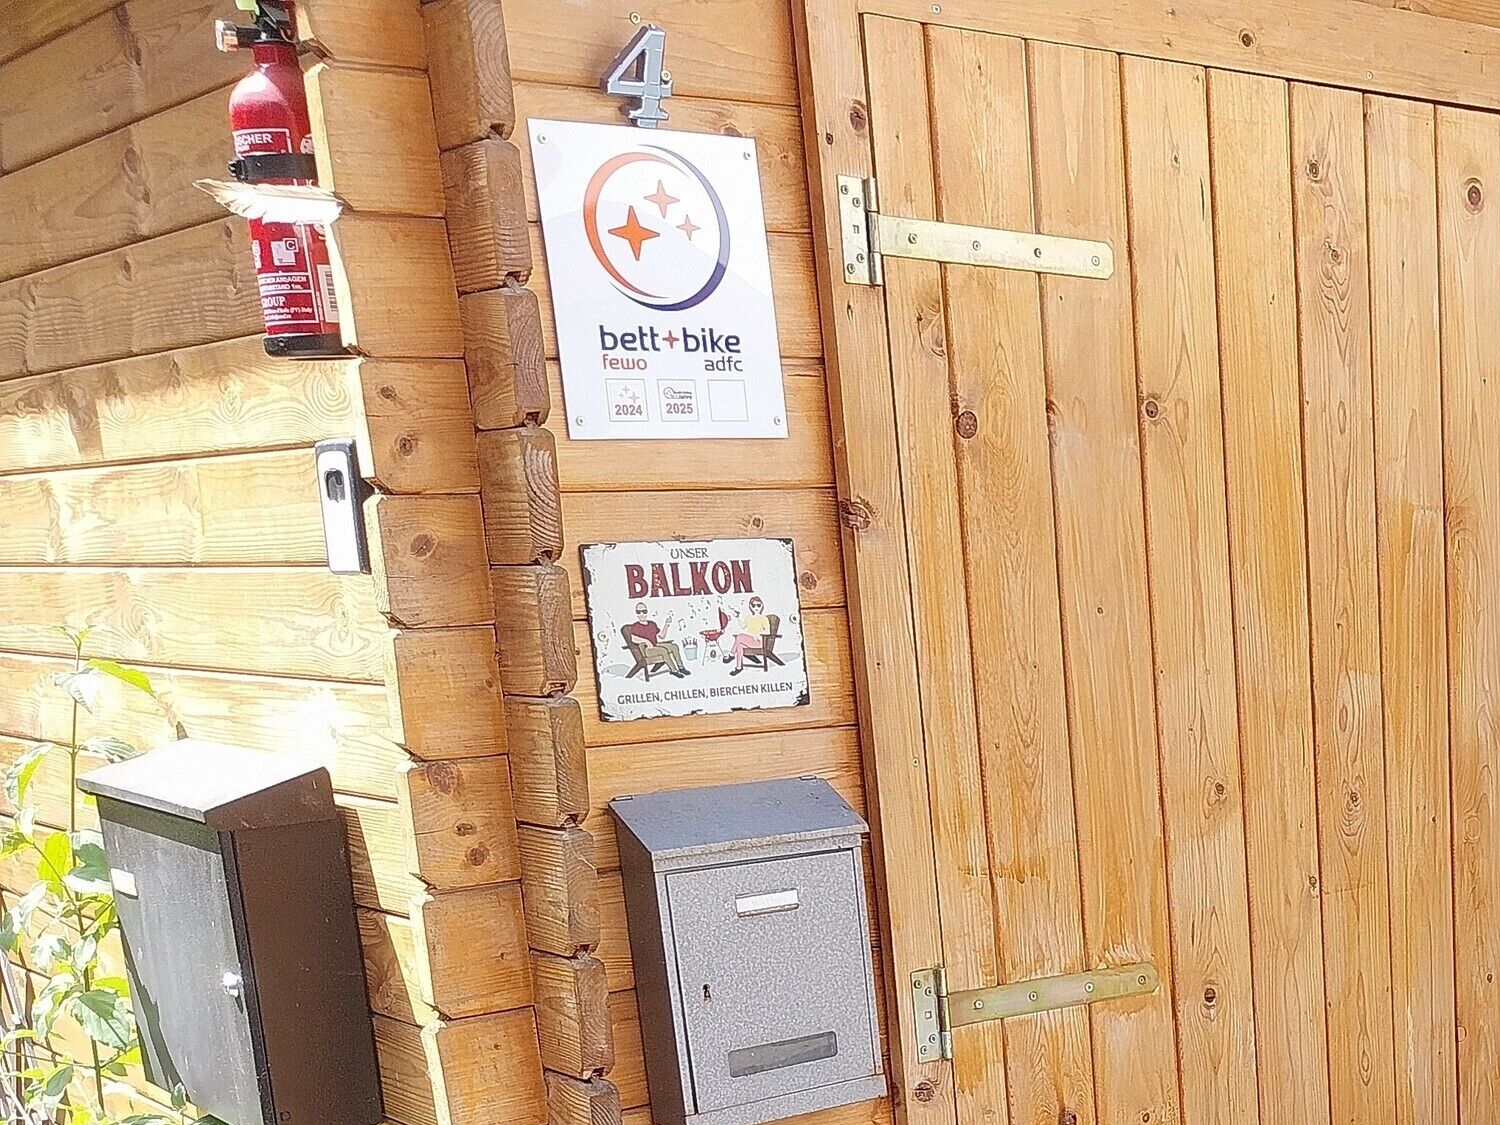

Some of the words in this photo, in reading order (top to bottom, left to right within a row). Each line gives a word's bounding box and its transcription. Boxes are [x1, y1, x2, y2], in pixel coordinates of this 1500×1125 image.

[607, 29, 673, 120] 4
[235, 133, 274, 146] SCHER
[602, 353, 647, 370] fewo
[704, 356, 743, 371] adfc
[615, 404, 643, 416] 2024
[666, 403, 693, 415] 2025
[670, 547, 709, 559] UNSER
[624, 559, 754, 599] BALKON
[617, 692, 663, 705] GRILLEN,
[664, 688, 709, 701] CHILLEN,
[710, 685, 759, 697] BIERCHEN
[760, 682, 793, 695] KILLEN
